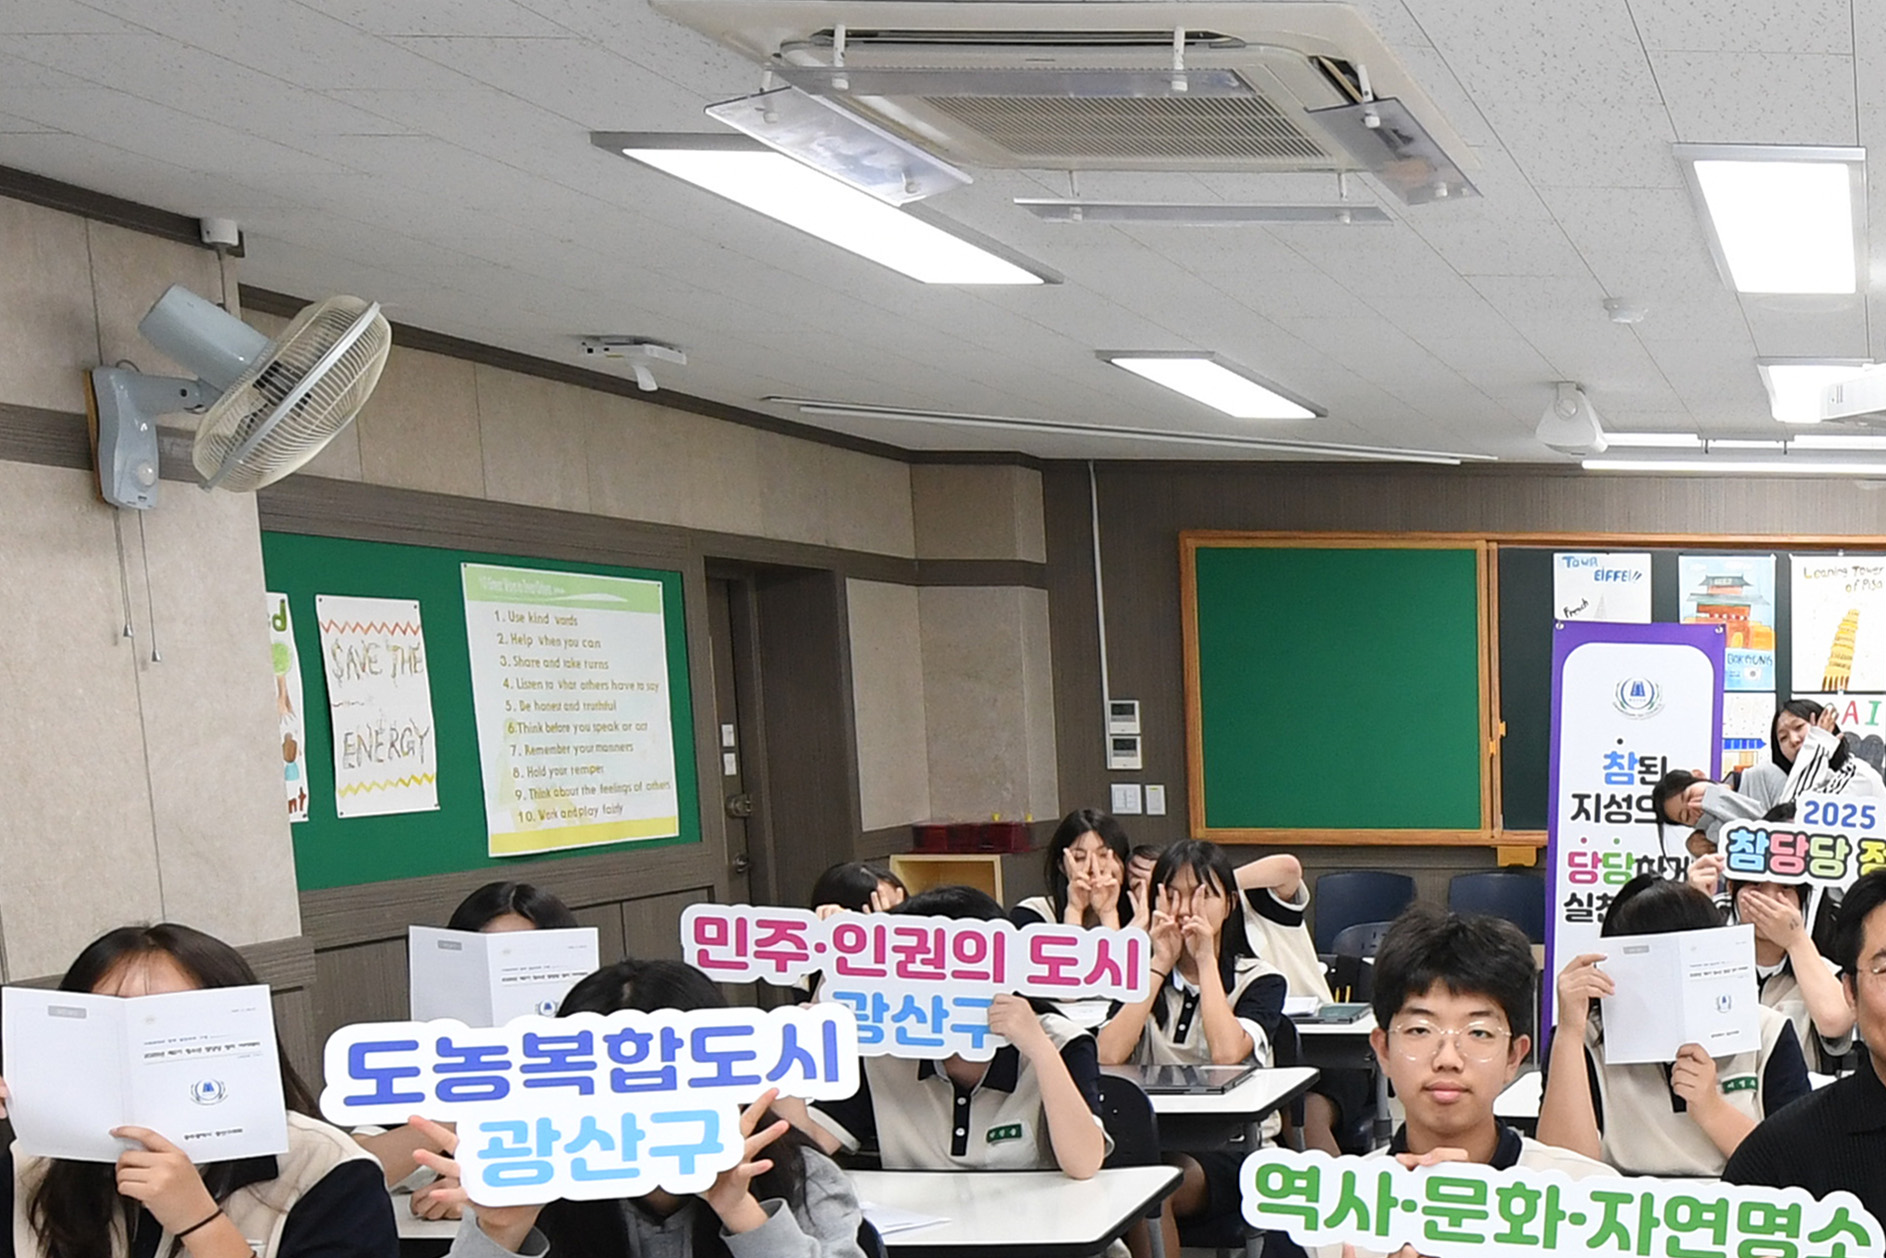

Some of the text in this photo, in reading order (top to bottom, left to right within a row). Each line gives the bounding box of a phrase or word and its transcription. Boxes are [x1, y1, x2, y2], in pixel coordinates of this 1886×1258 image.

[508, 611, 525, 623] Use
[528, 611, 549, 624] kind
[511, 634, 533, 646] Help
[563, 638, 579, 650] you
[582, 639, 601, 649] can
[330, 637, 425, 687] SAVE THE
[513, 655, 540, 668] Share
[543, 656, 560, 669] and
[584, 659, 609, 670] turns
[516, 678, 543, 690] Listen
[580, 679, 609, 691] others
[611, 679, 635, 691] have
[646, 681, 660, 693] say
[563, 700, 580, 712] and
[545, 722, 570, 734] before
[573, 723, 591, 734] you
[593, 721, 619, 734] speak
[342, 717, 430, 770] ENERGY
[524, 744, 571, 756] Remember
[526, 766, 546, 778] Hold
[571, 764, 604, 777] temper
[1603, 751, 1667, 785] 참된
[528, 788, 551, 800] Think
[553, 786, 579, 798] about
[581, 785, 597, 796] the
[1570, 792, 1659, 824] 지성으
[1803, 800, 1877, 830] 2025
[1728, 828, 1850, 880] 참당당
[693, 916, 1139, 991] 민주·인권의 도시
[833, 991, 994, 1049] 광산구
[343, 1019, 841, 1107] 도농복합도시
[476, 1109, 725, 1188] 광산구
